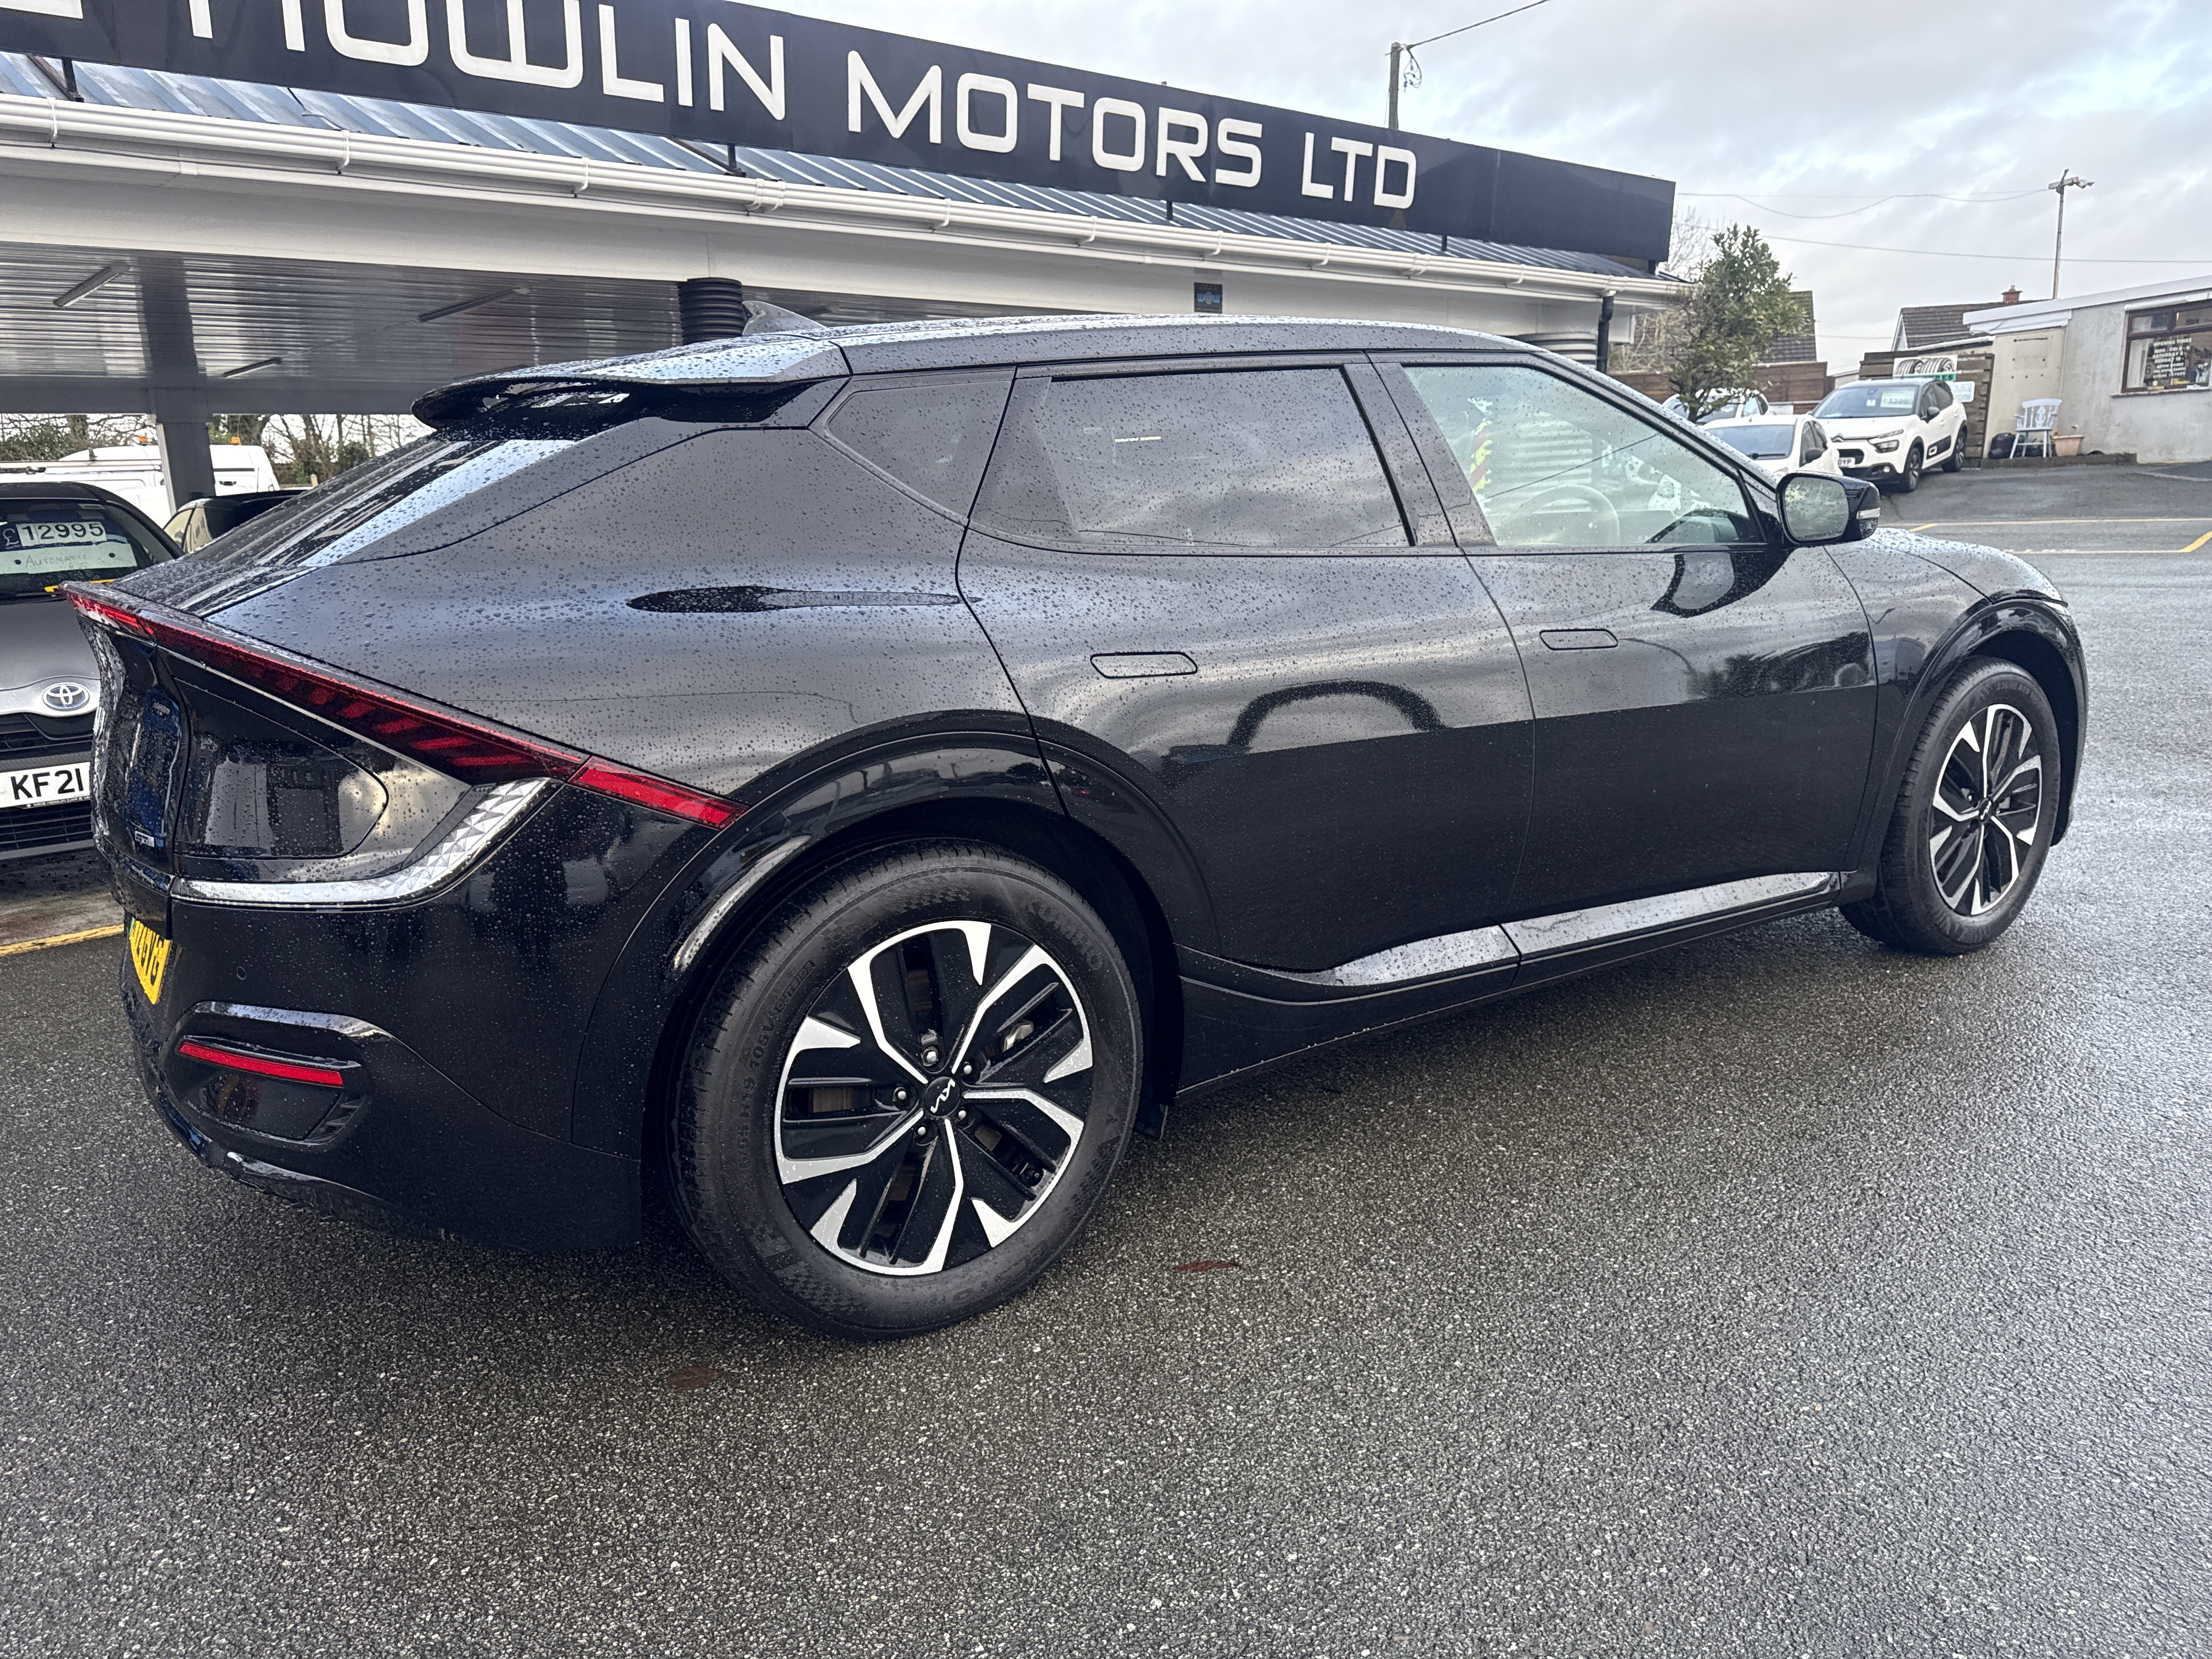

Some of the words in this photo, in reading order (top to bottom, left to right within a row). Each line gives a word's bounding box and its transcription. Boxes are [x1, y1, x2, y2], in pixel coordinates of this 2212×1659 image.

[848, 50, 1263, 188] MOTORS
[1301, 132, 1416, 209] LTD
[10, 768, 84, 800] KF21
[775, 959, 816, 1013] OUTSIDE
